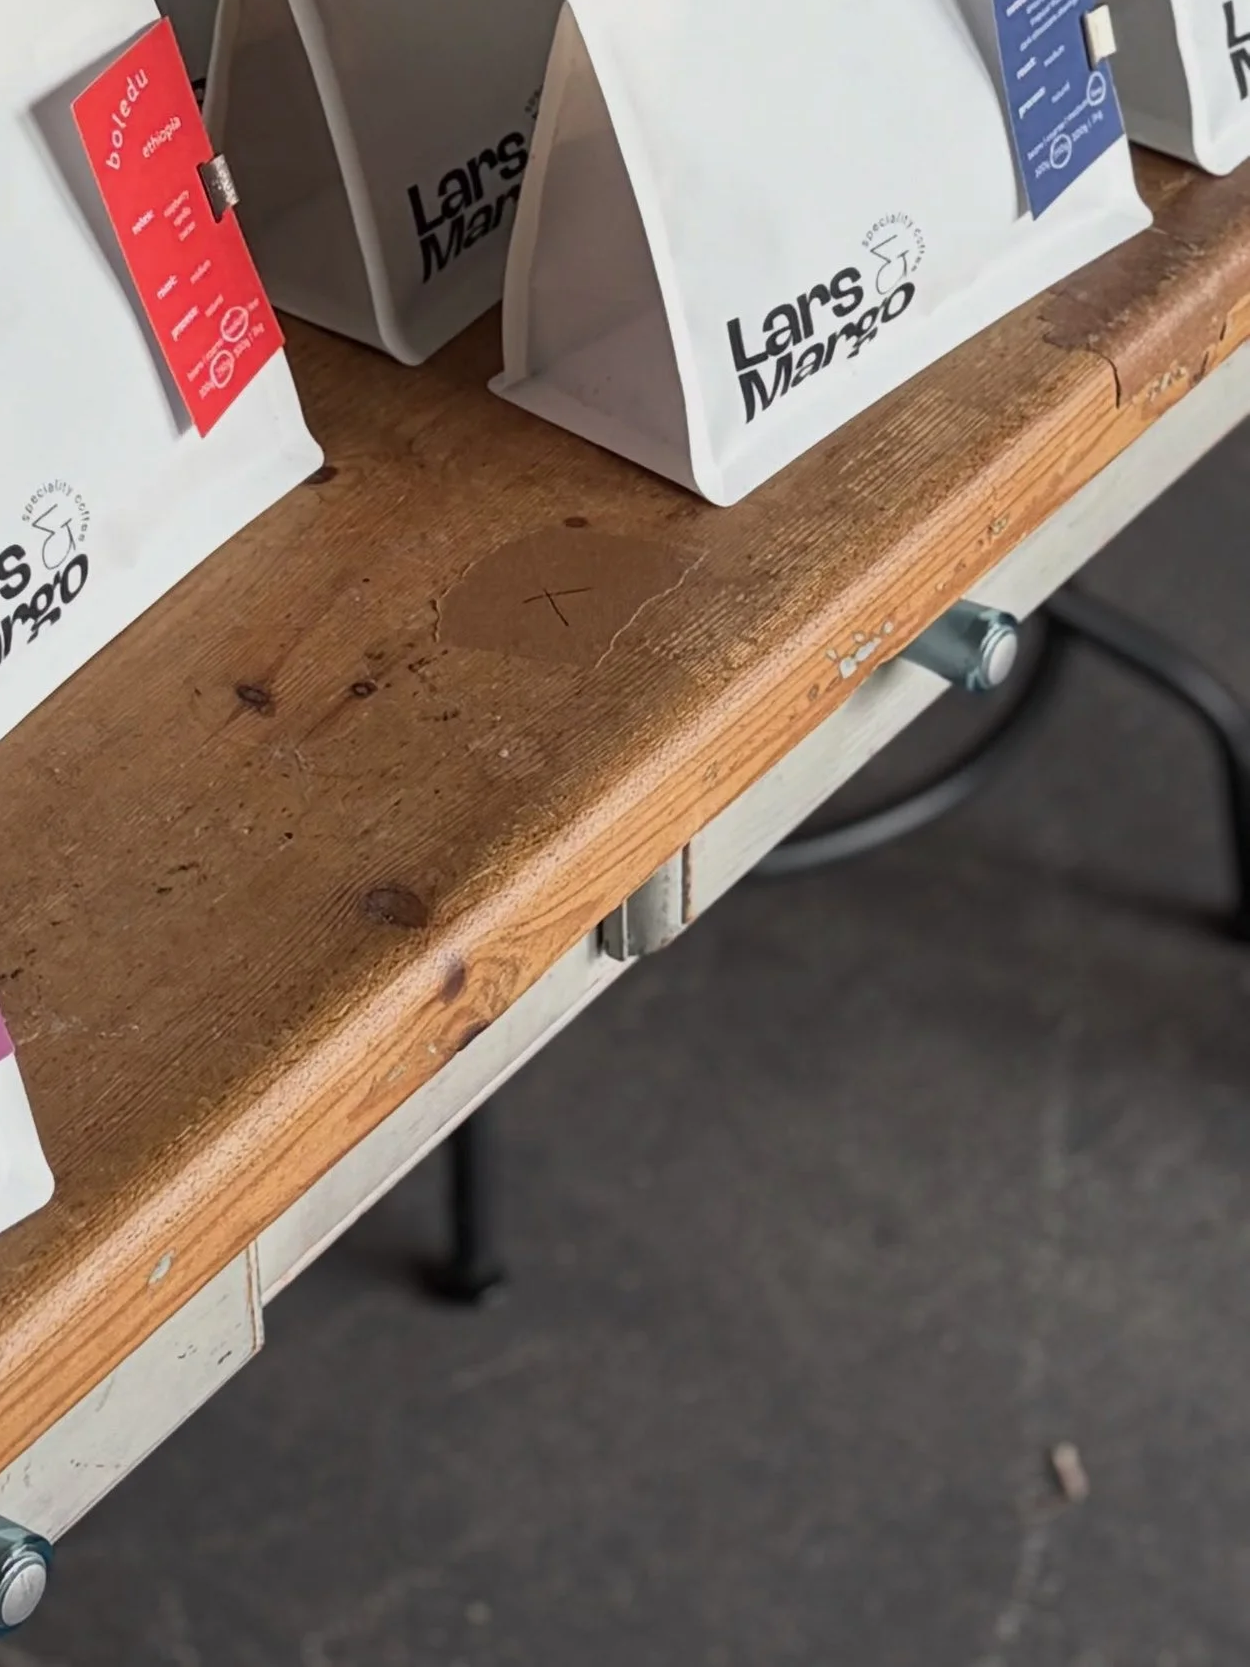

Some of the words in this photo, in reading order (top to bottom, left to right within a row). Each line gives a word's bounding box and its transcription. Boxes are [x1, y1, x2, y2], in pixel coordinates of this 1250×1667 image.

[106, 69, 149, 170] boledu
[142, 116, 182, 158] ethiopia
[407, 132, 529, 237] Lars
[420, 185, 521, 284] Mar
[727, 267, 864, 372] Lars
[738, 282, 915, 424] Margo
